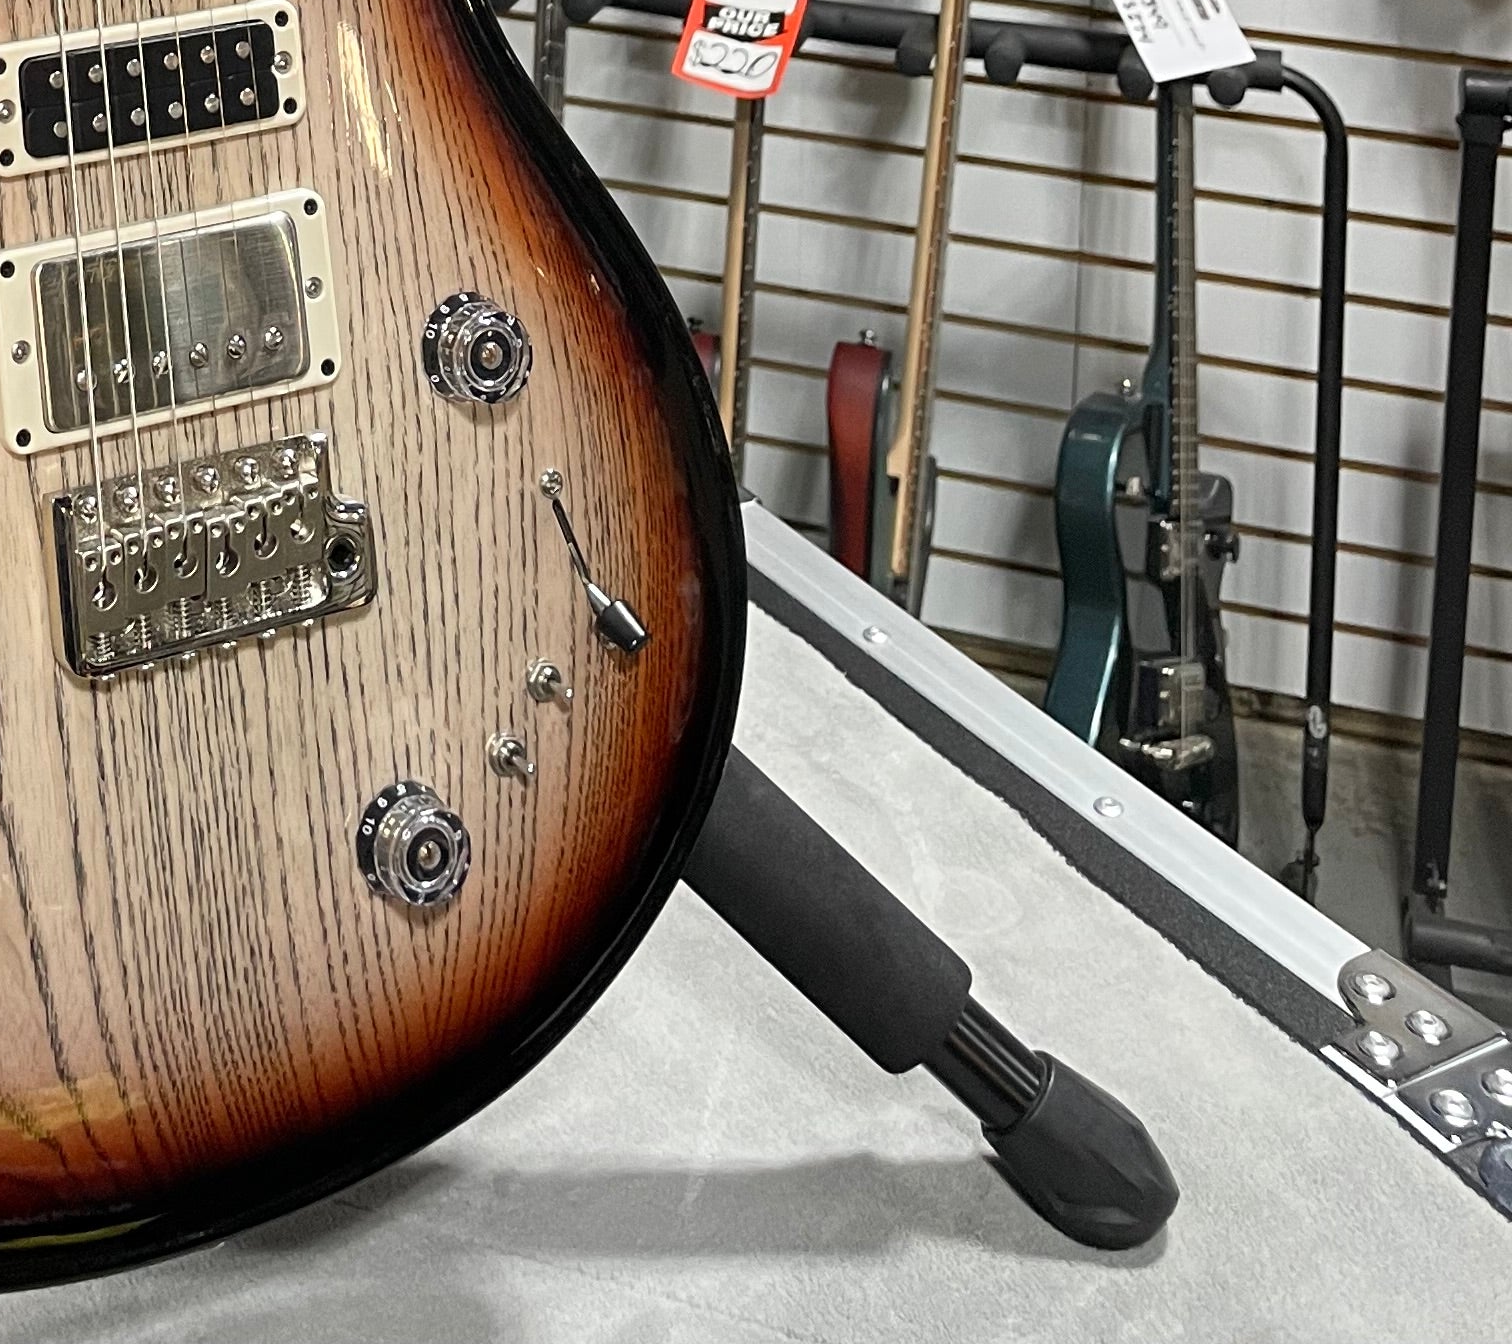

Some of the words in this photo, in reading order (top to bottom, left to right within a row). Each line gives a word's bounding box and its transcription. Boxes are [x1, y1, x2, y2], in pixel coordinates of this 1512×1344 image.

[719, 6, 771, 26] OUR
[707, 16, 780, 38] PRICE
[690, 39, 779, 80] $220
[425, 322, 438, 340] 10
[430, 374, 440, 383] 0
[361, 817, 376, 836] 10
